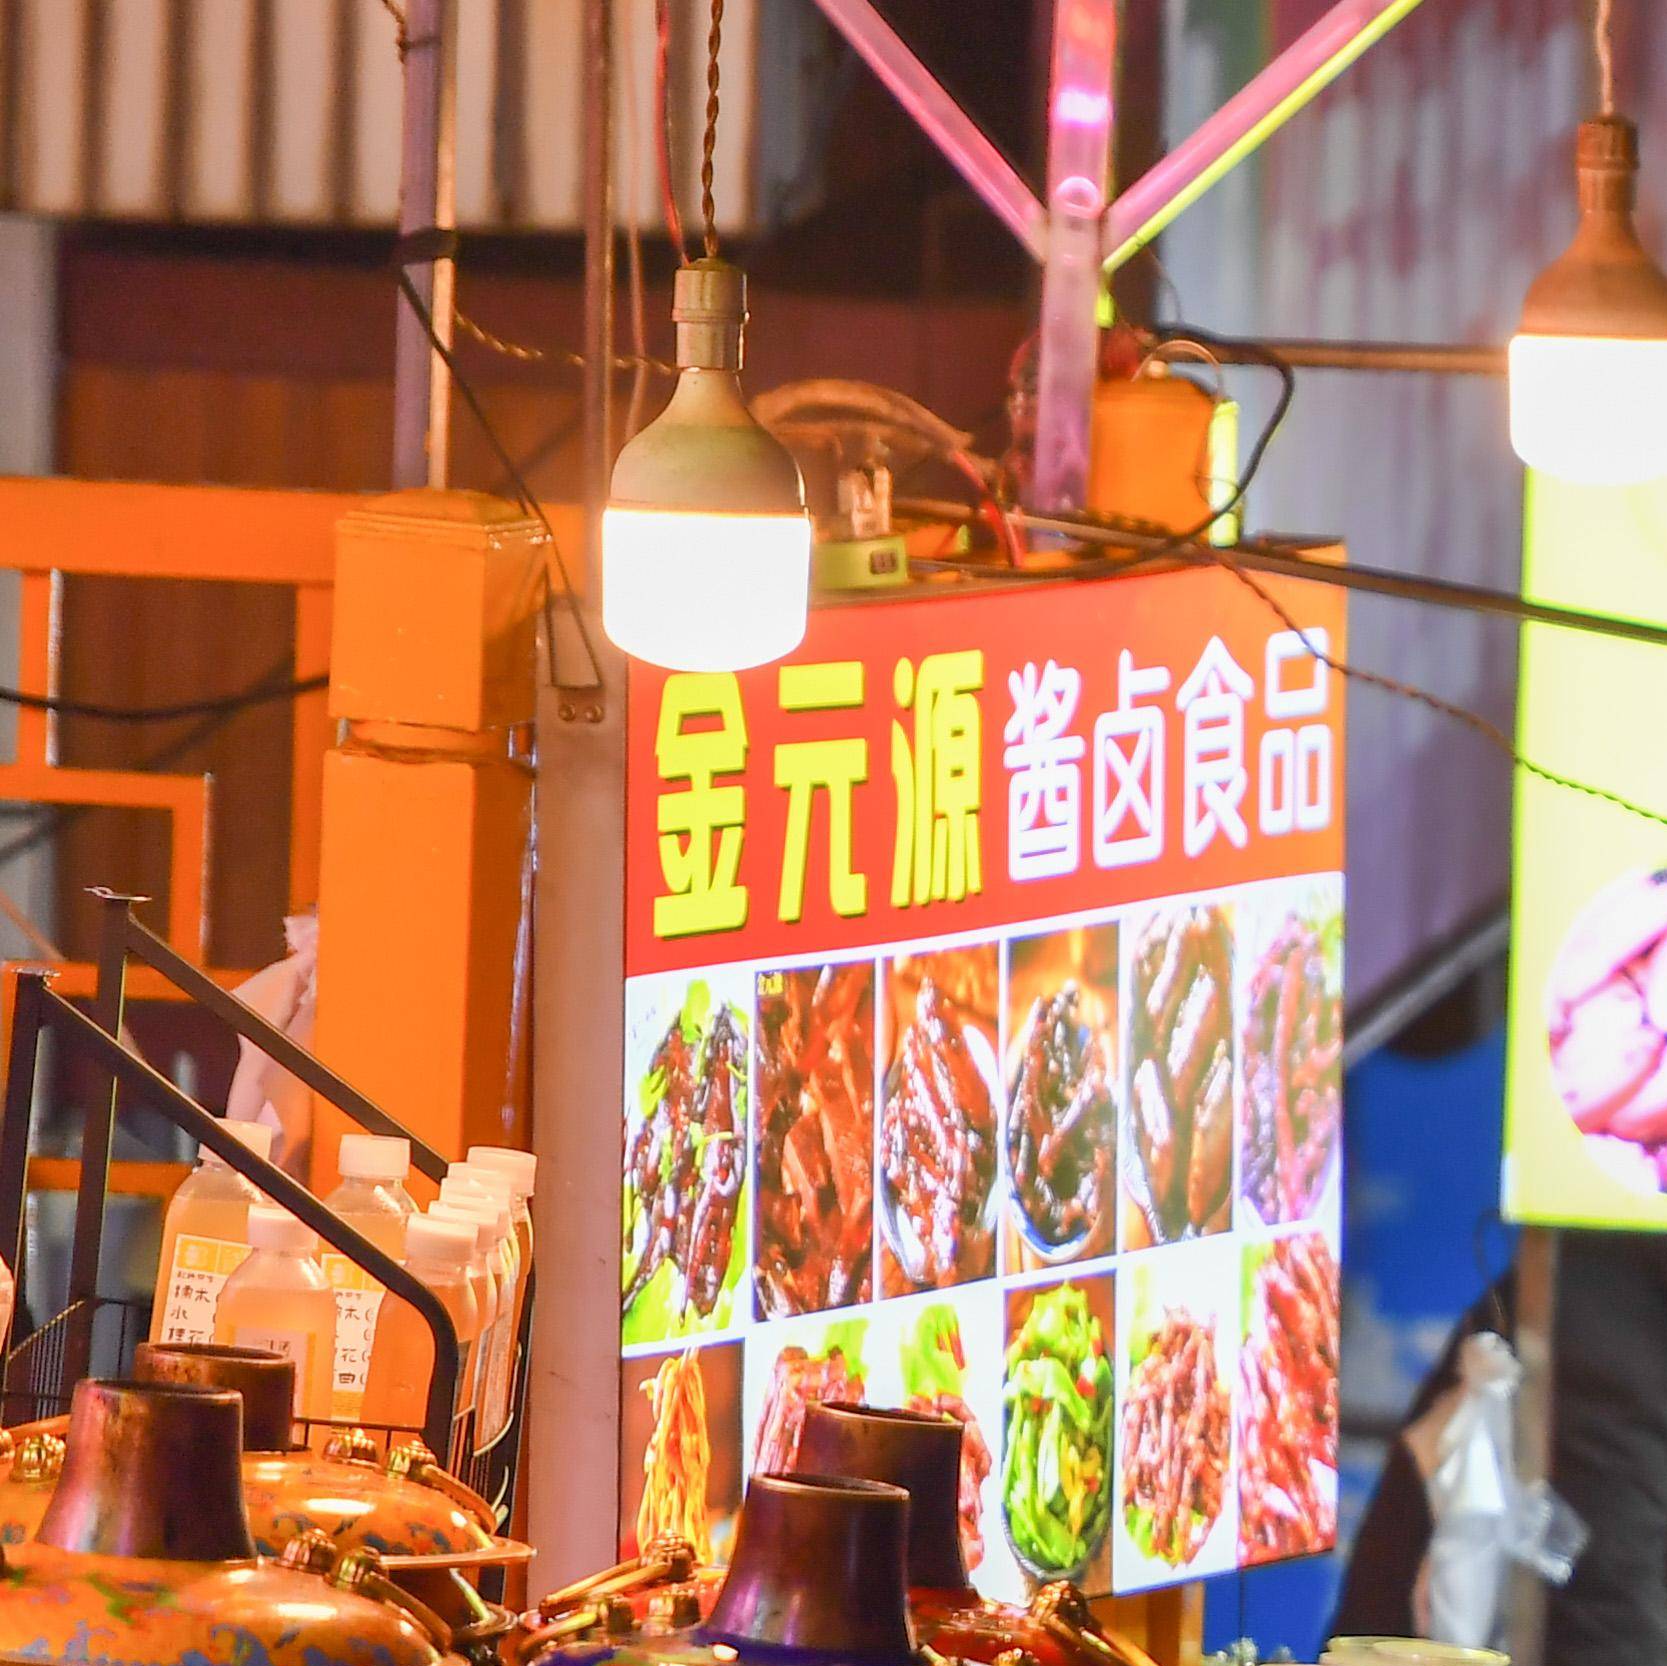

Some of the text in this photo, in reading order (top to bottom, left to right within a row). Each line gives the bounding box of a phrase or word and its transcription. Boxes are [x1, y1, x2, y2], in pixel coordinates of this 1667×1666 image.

[653, 627, 1334, 938] 金元源 酱卤食品
